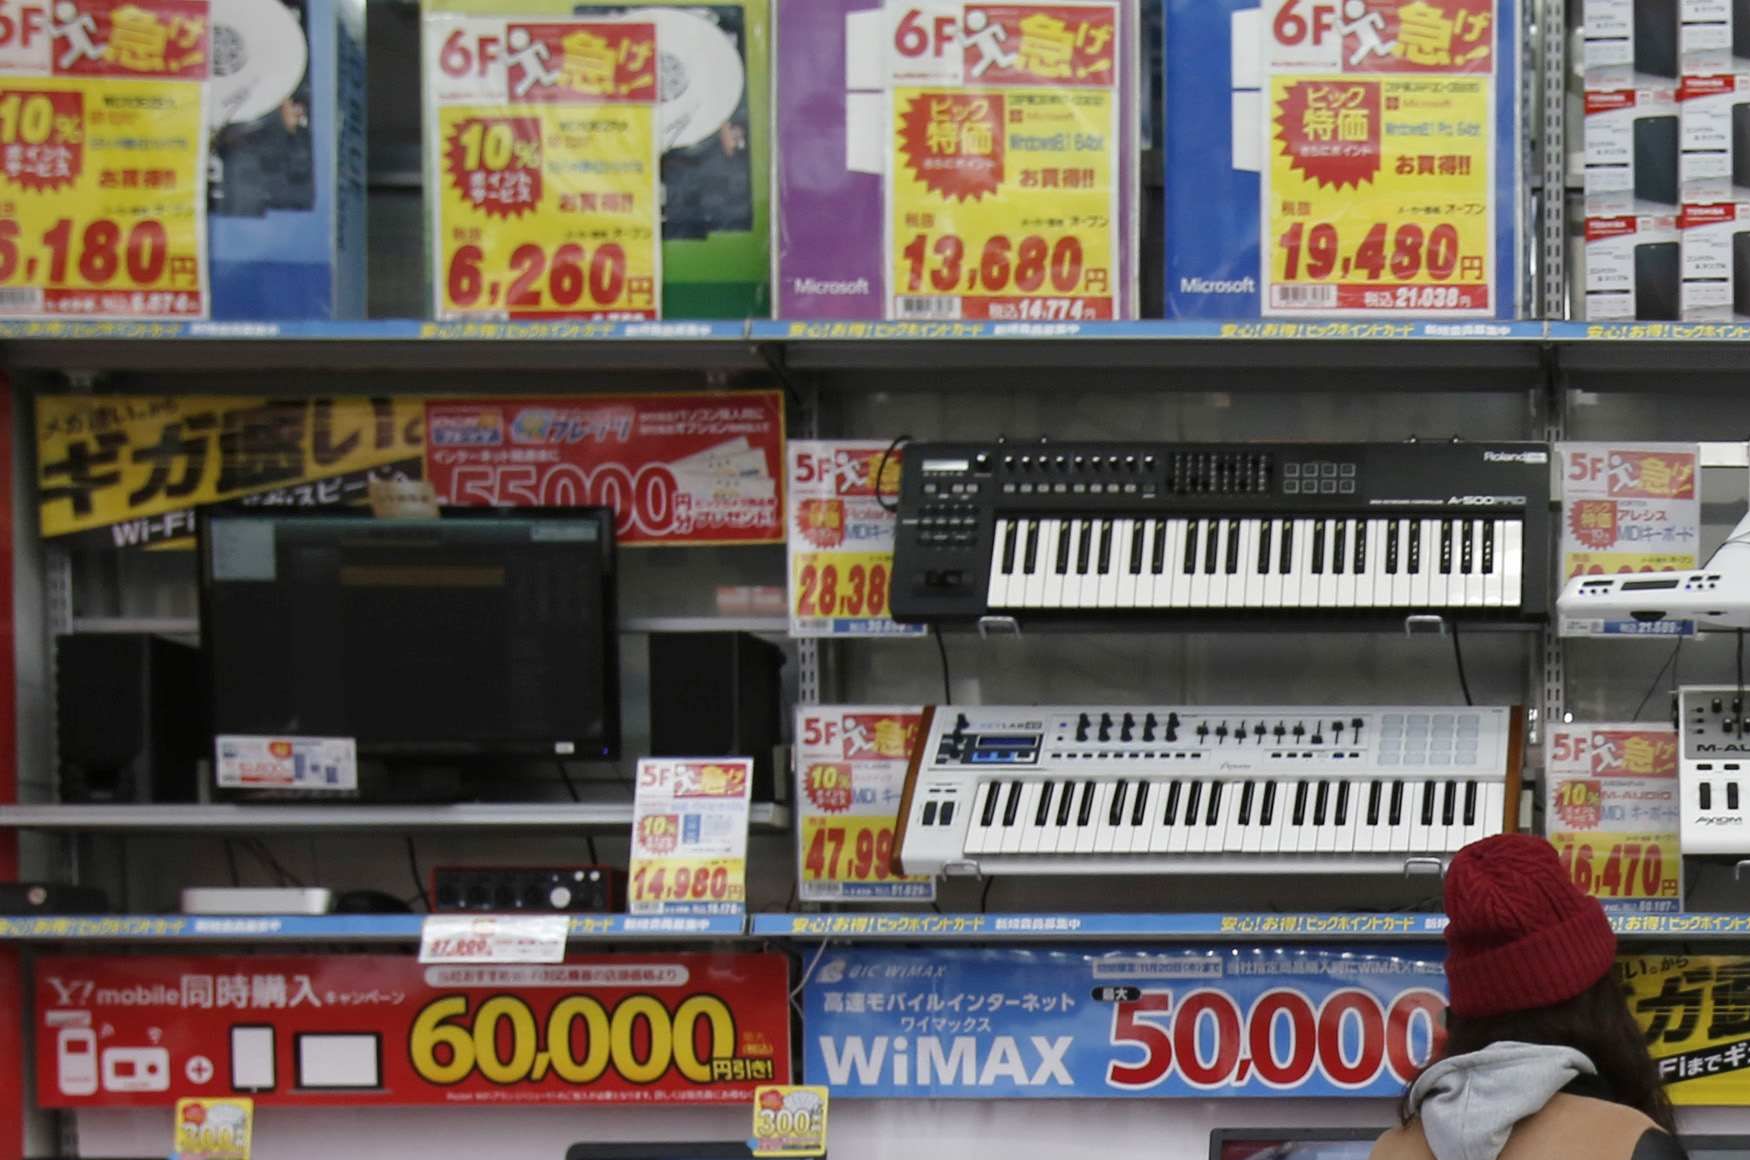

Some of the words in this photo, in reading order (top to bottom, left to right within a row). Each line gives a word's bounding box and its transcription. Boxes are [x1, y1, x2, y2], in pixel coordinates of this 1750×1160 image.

[894, 9, 957, 59] 6F
[1272, 0, 1337, 47] 6F
[439, 29, 499, 77] 6F
[1303, 108, 1370, 143] 特価
[459, 122, 543, 171] 10%
[903, 233, 1108, 293] 13,680円
[1279, 222, 1485, 281] 19,480円
[795, 276, 869, 295] Microsoft
[1181, 275, 1254, 294] Microsoft
[795, 453, 832, 483] 5F
[1567, 452, 1605, 482] 5F
[111, 511, 196, 546] Wi-Fi
[1617, 509, 1668, 522] アレシス
[802, 717, 839, 746] 5F
[1551, 732, 1588, 762] 5F
[1601, 790, 1672, 801] M-AUDIO
[823, 992, 1076, 1014] 高速モバイルインターネット
[410, 995, 736, 1084] 60,000
[900, 1016, 993, 1034] ワイマックス
[818, 1034, 1075, 1087] WiMAX
